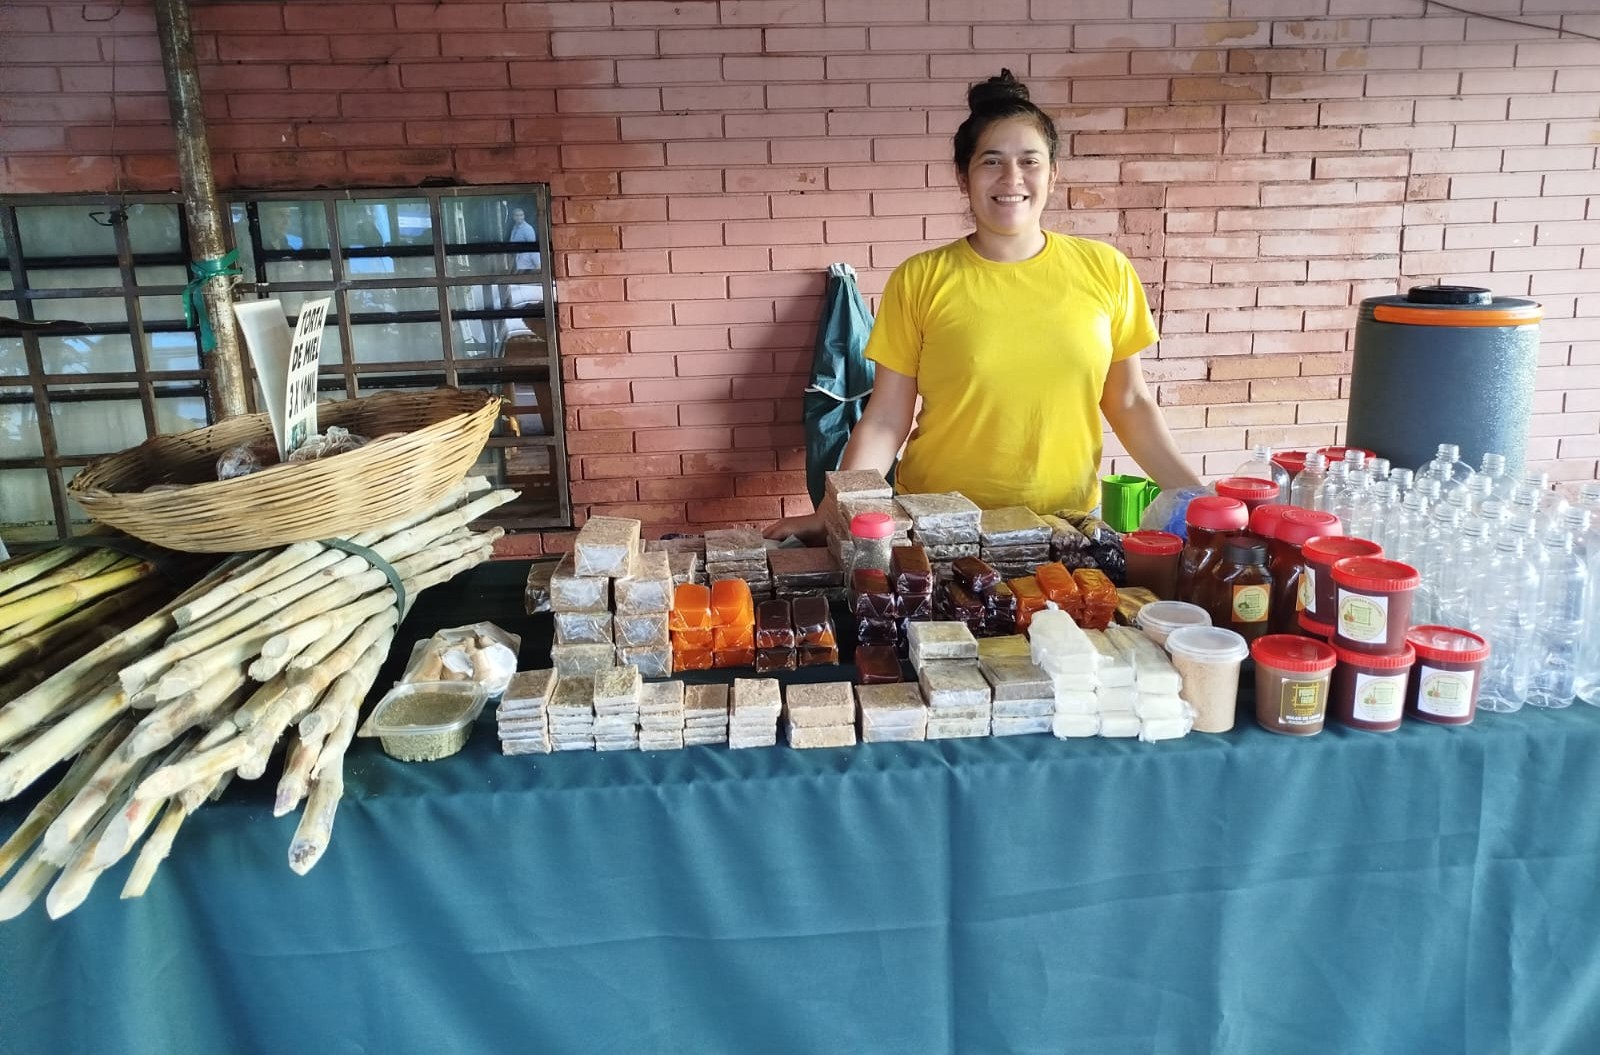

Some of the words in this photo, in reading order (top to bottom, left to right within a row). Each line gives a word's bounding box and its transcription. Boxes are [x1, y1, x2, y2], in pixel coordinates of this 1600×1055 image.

[300, 306, 324, 336] TORTA
[292, 342, 304, 372] DE
[303, 336, 320, 366] MIEL
